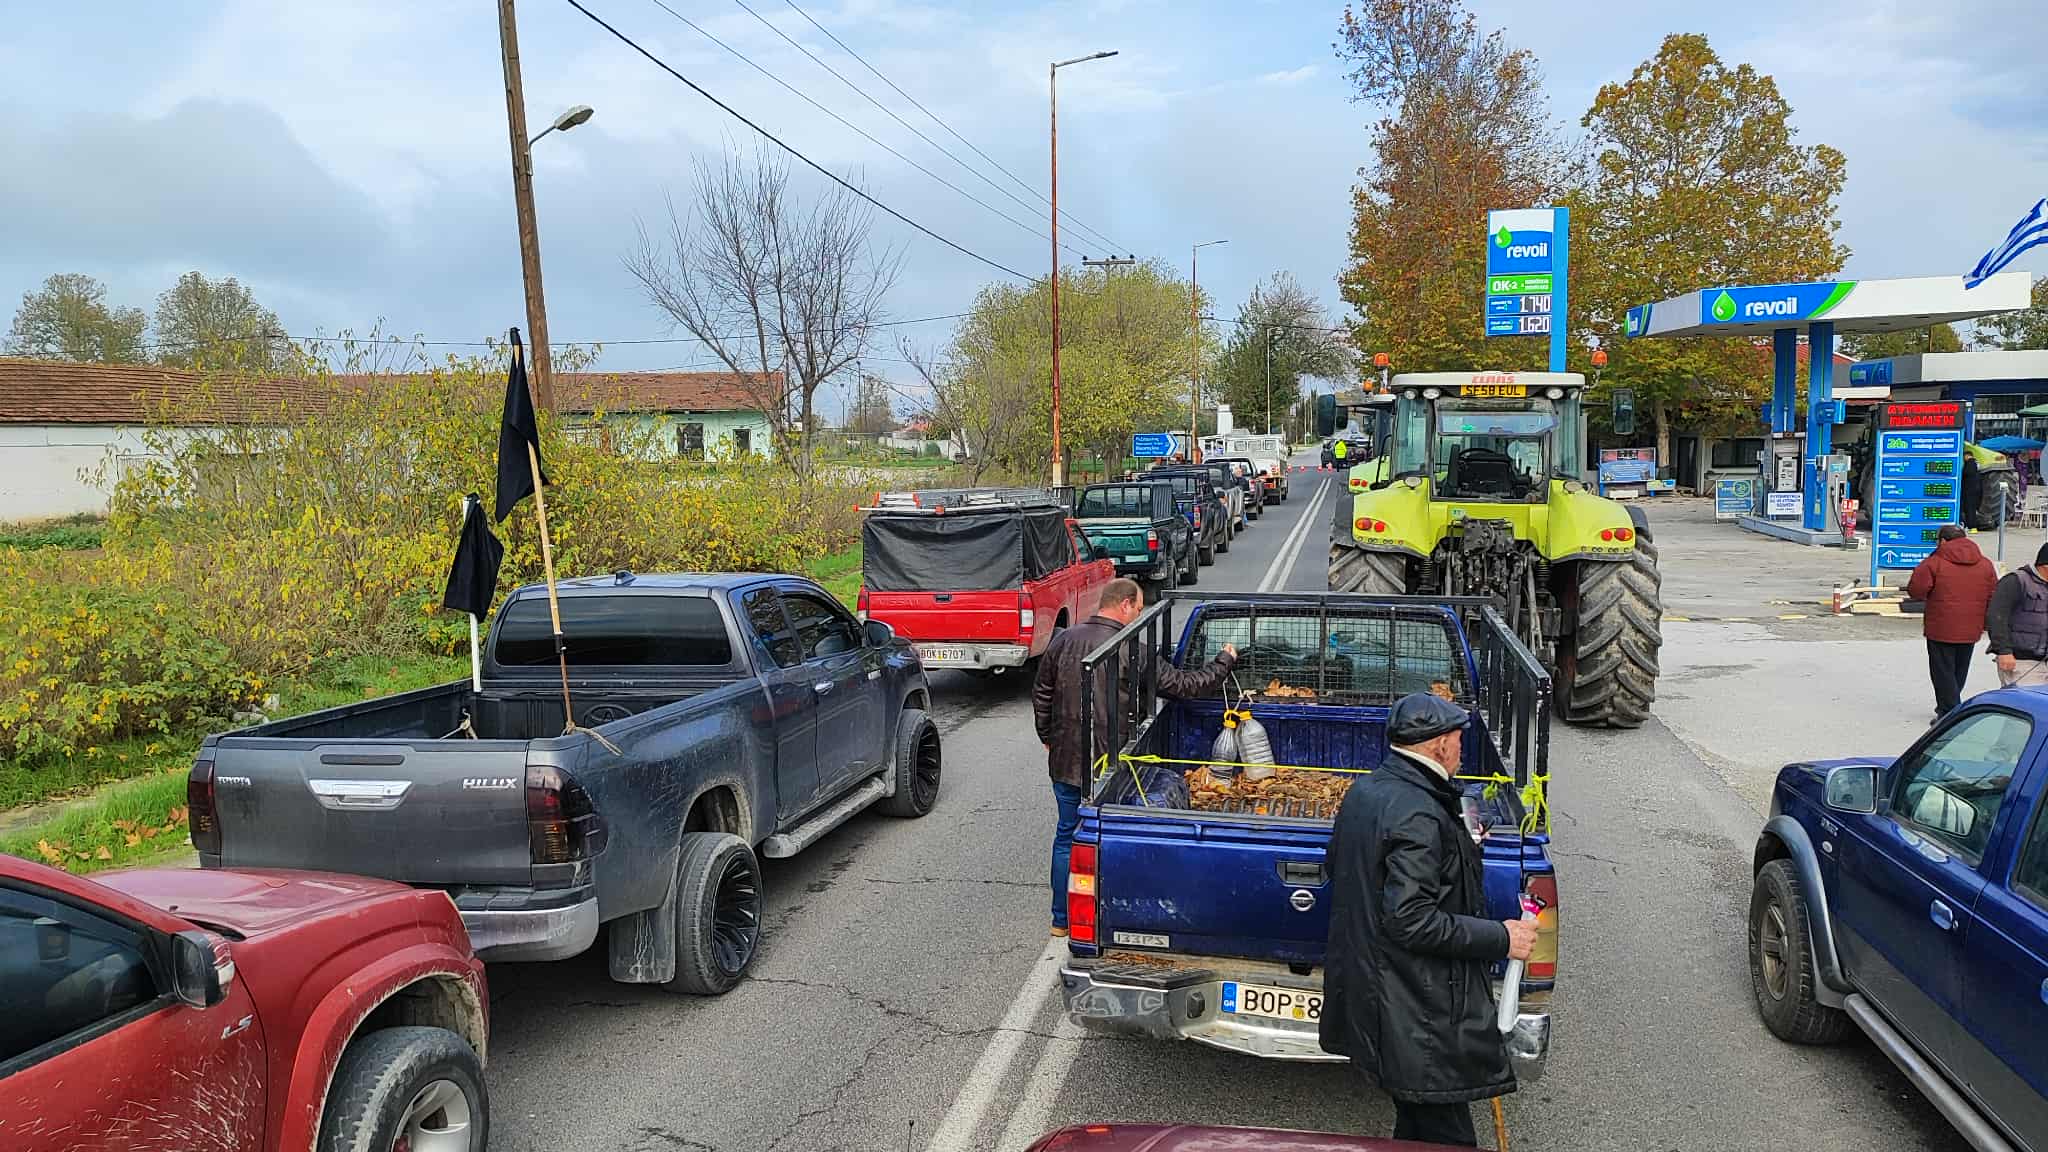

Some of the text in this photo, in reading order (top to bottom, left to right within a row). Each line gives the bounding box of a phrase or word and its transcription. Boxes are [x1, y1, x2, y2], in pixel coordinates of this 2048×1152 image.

[1506, 242, 1548, 258] revoil
[1745, 296, 1798, 316] revoil
[216, 776, 252, 786] TOYOTA
[463, 777, 519, 789] HILUX
